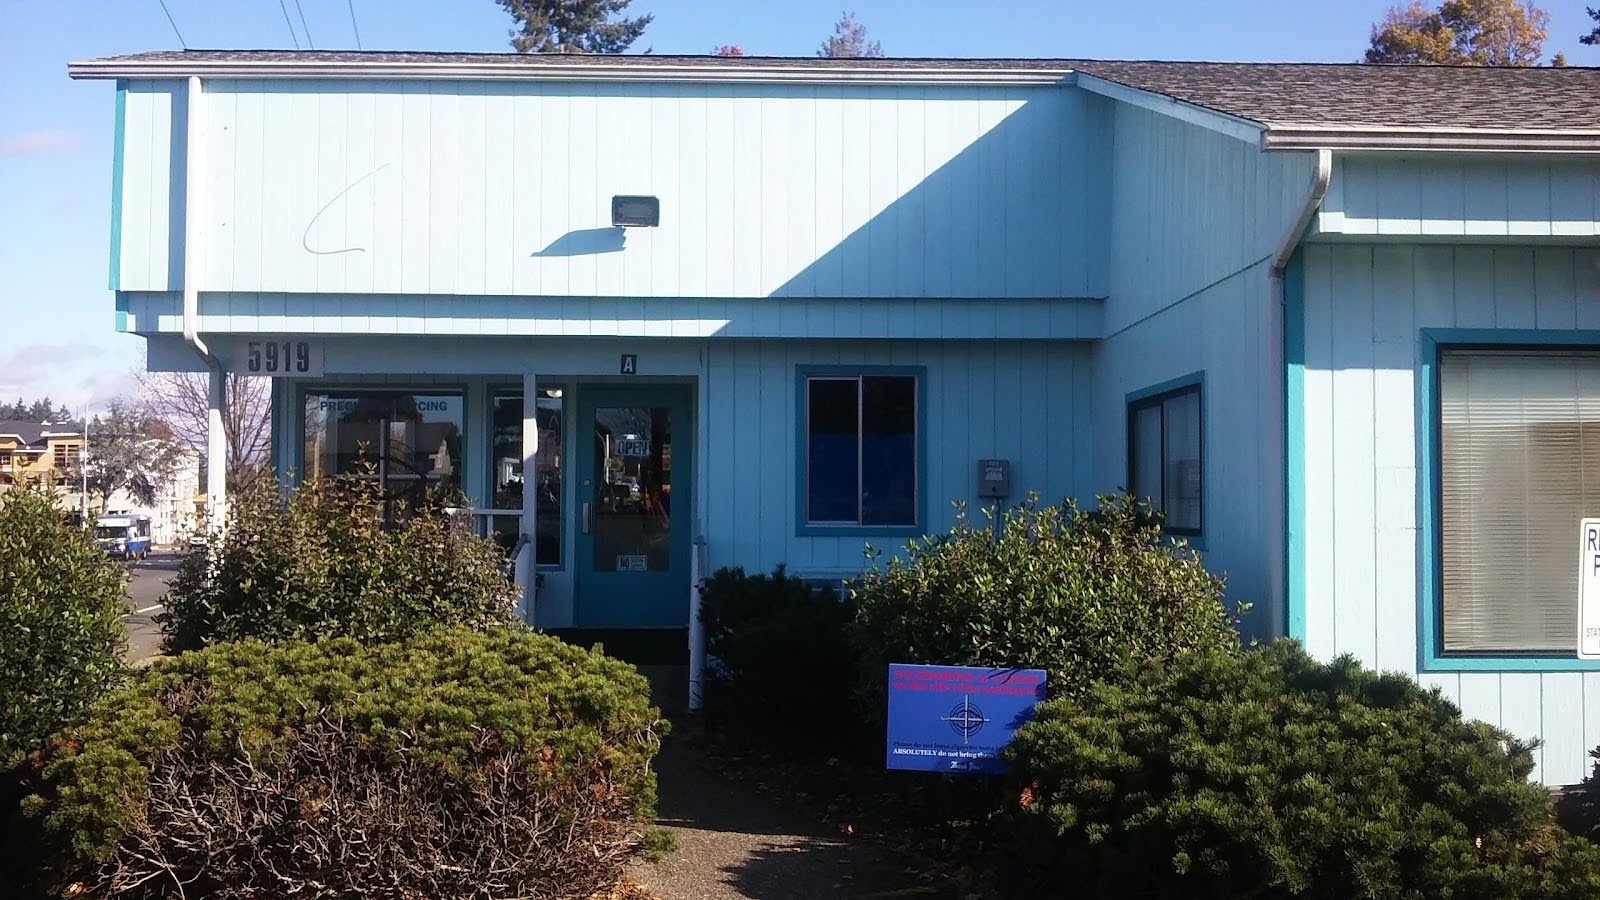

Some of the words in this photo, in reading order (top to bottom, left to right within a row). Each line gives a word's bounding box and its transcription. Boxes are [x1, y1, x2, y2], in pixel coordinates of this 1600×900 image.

[248, 342, 309, 372] 5919
[623, 357, 633, 372] A
[618, 441, 648, 455] OPEN
[620, 558, 630, 568] NO
[893, 748, 937, 757] ABSOLUTELY
[959, 751, 977, 759] bring
